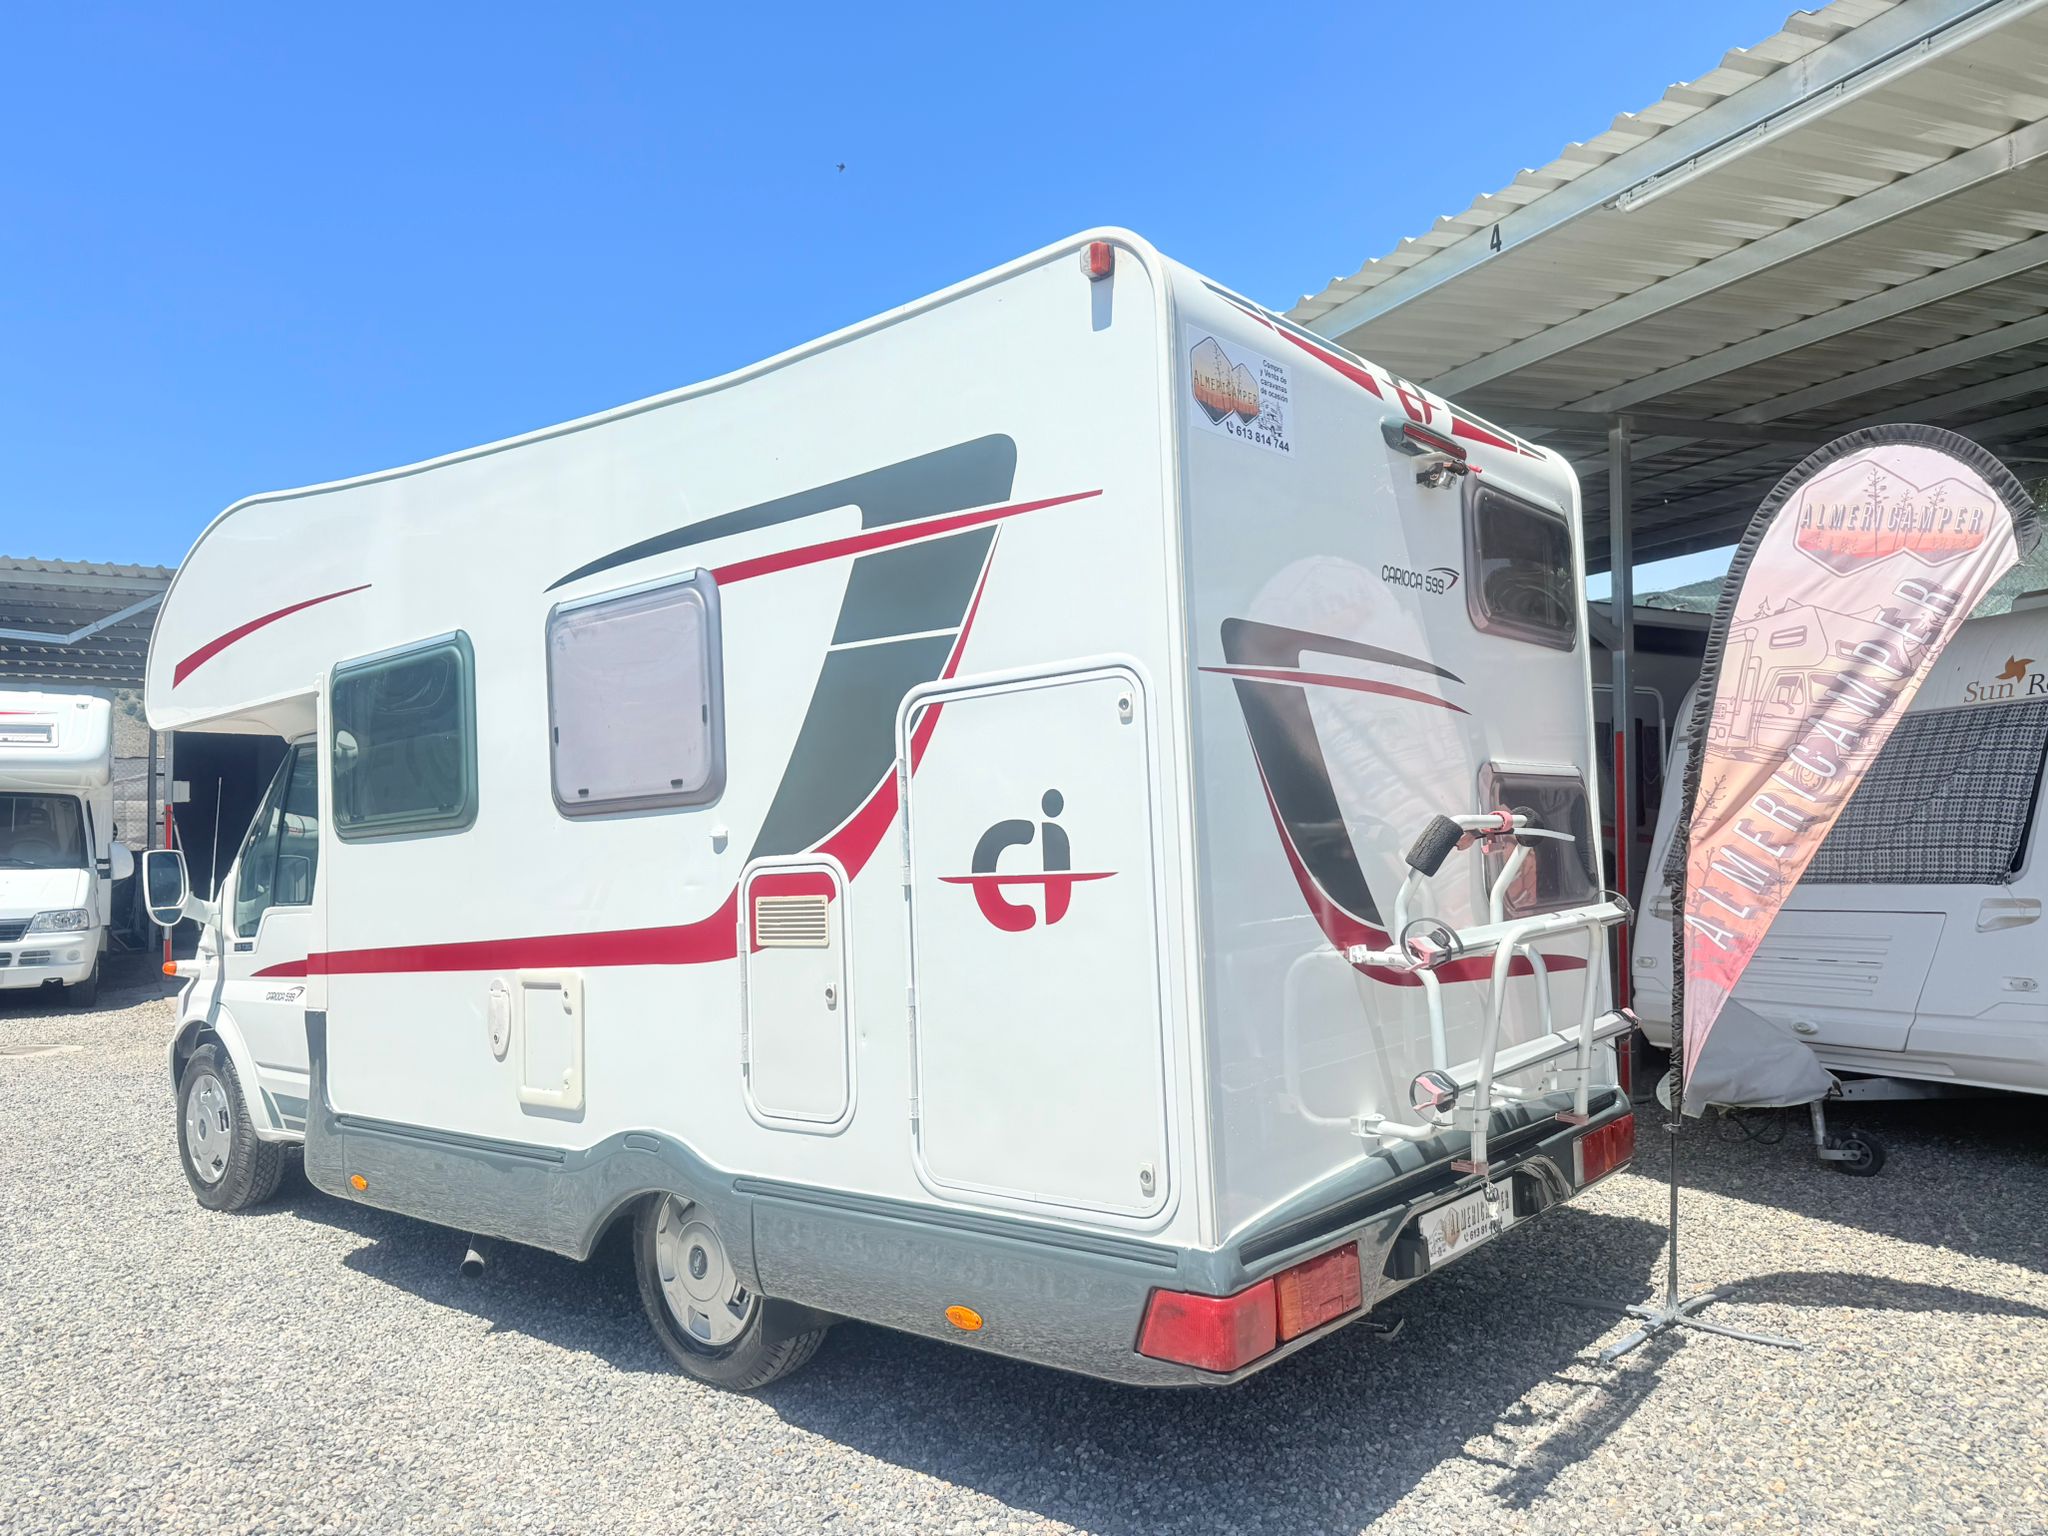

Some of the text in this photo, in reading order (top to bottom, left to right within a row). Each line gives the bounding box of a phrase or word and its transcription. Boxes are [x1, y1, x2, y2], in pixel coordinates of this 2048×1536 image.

[1489, 222, 1503, 253] 4
[1262, 359, 1283, 374] Compra
[1264, 368, 1280, 381] Venta
[1280, 376, 1288, 385] de
[1192, 369, 1259, 406] ALMERICAMPER
[1260, 378, 1288, 394] caravanas
[1260, 387, 1268, 396] de
[1236, 425, 1290, 452] 613 814 744
[1800, 502, 1985, 534] ALMERICAMPER
[1381, 564, 1445, 595] CARIOCA 599
[1963, 673, 2048, 703] Sun R
[1684, 577, 1962, 951] ALMERICAMPER
[1469, 1227, 1481, 1241] 613
